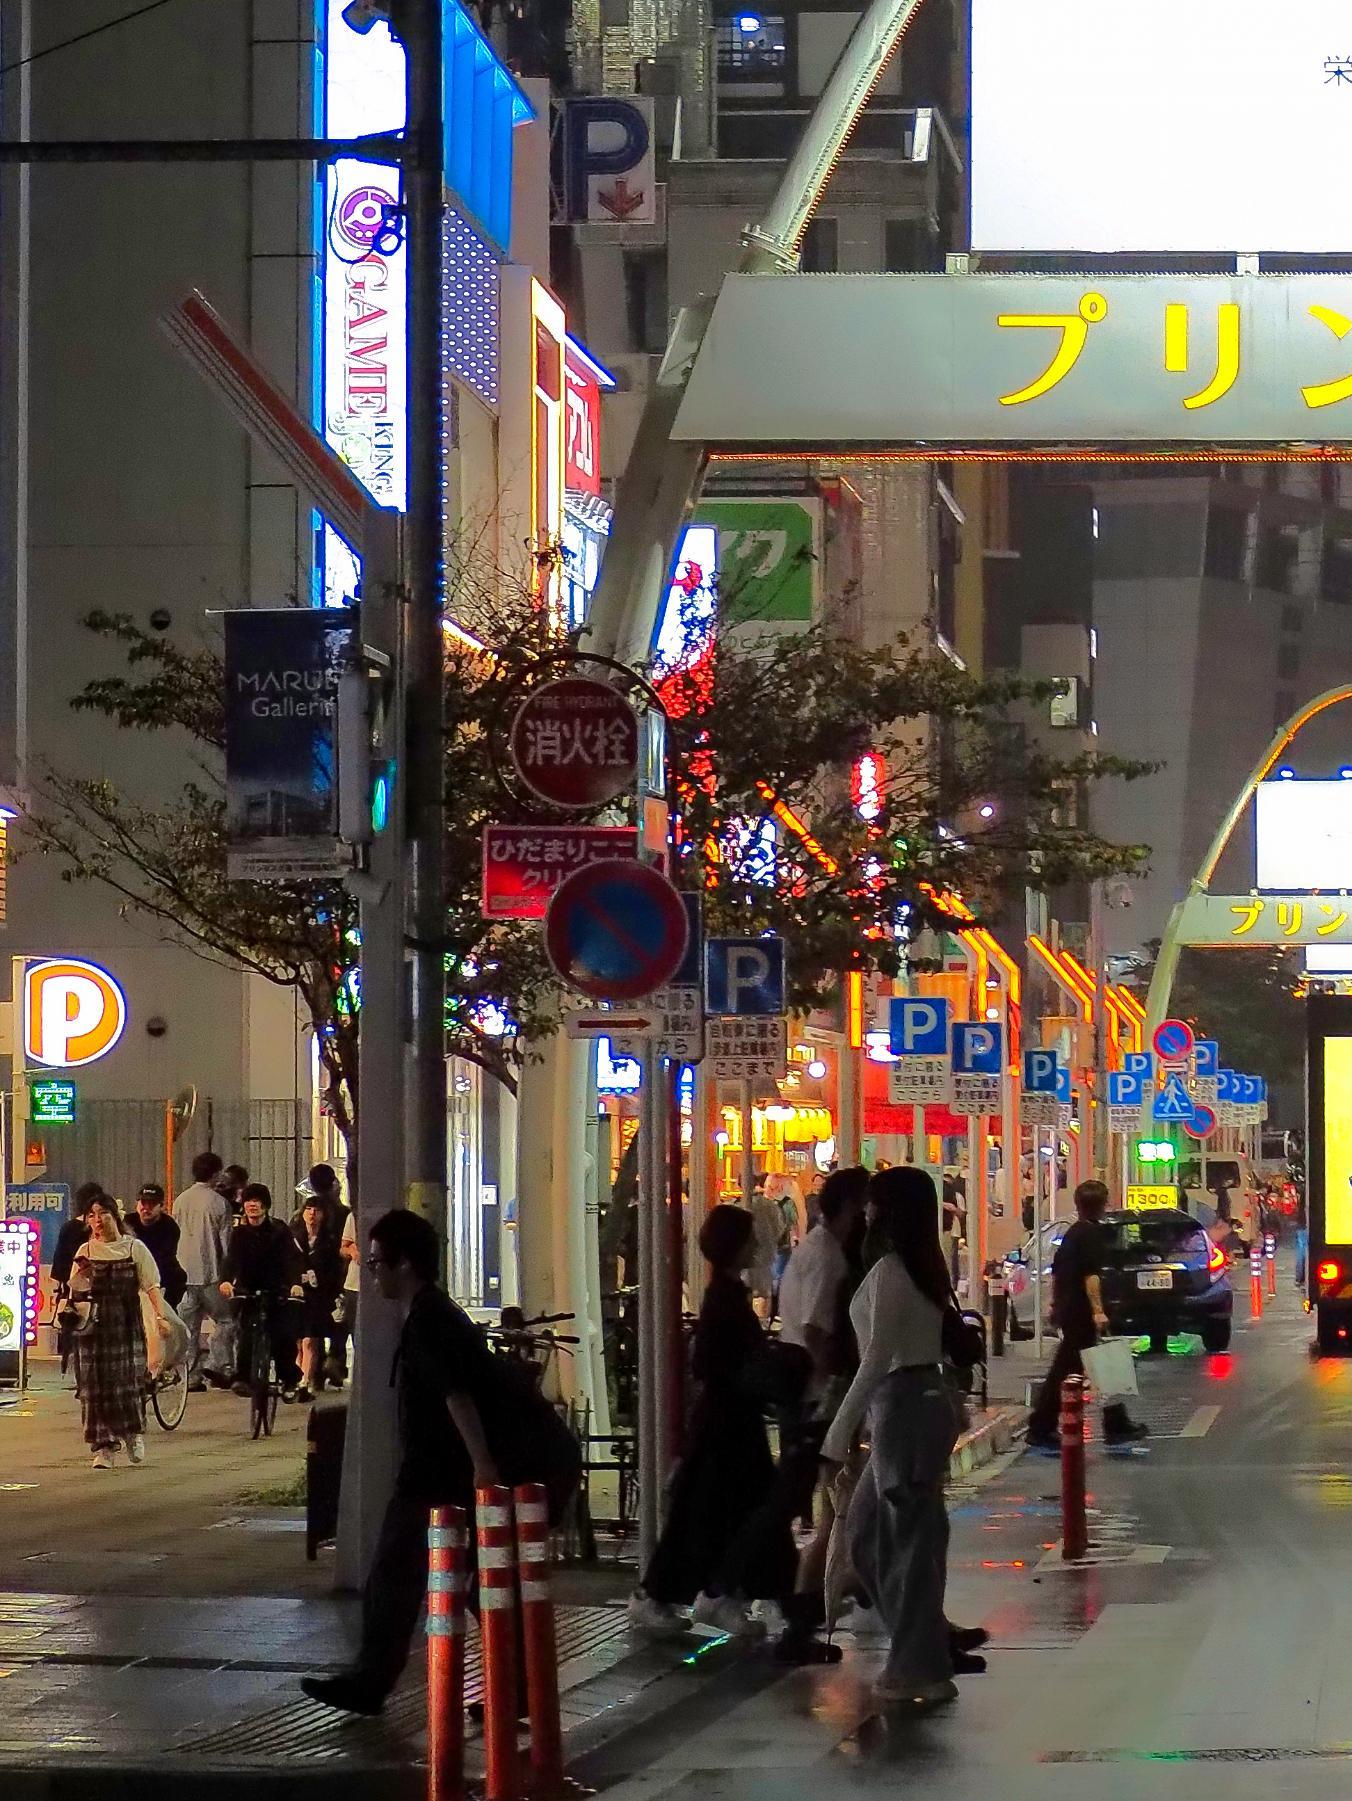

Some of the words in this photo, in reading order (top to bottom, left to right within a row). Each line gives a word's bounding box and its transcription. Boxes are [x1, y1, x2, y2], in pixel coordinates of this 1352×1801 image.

[567, 99, 649, 220] P
[345, 253, 388, 415] GAME
[525, 718, 630, 766] 消火栓
[728, 946, 769, 1014] P
[41, 974, 105, 1067] P
[903, 1003, 937, 1050] P
[714, 1061, 775, 1076] ここまで
[963, 1027, 995, 1068] P
[1032, 1054, 1050, 1087] P
[1117, 1075, 1137, 1102] P
[8, 1192, 65, 1212] 利用可
